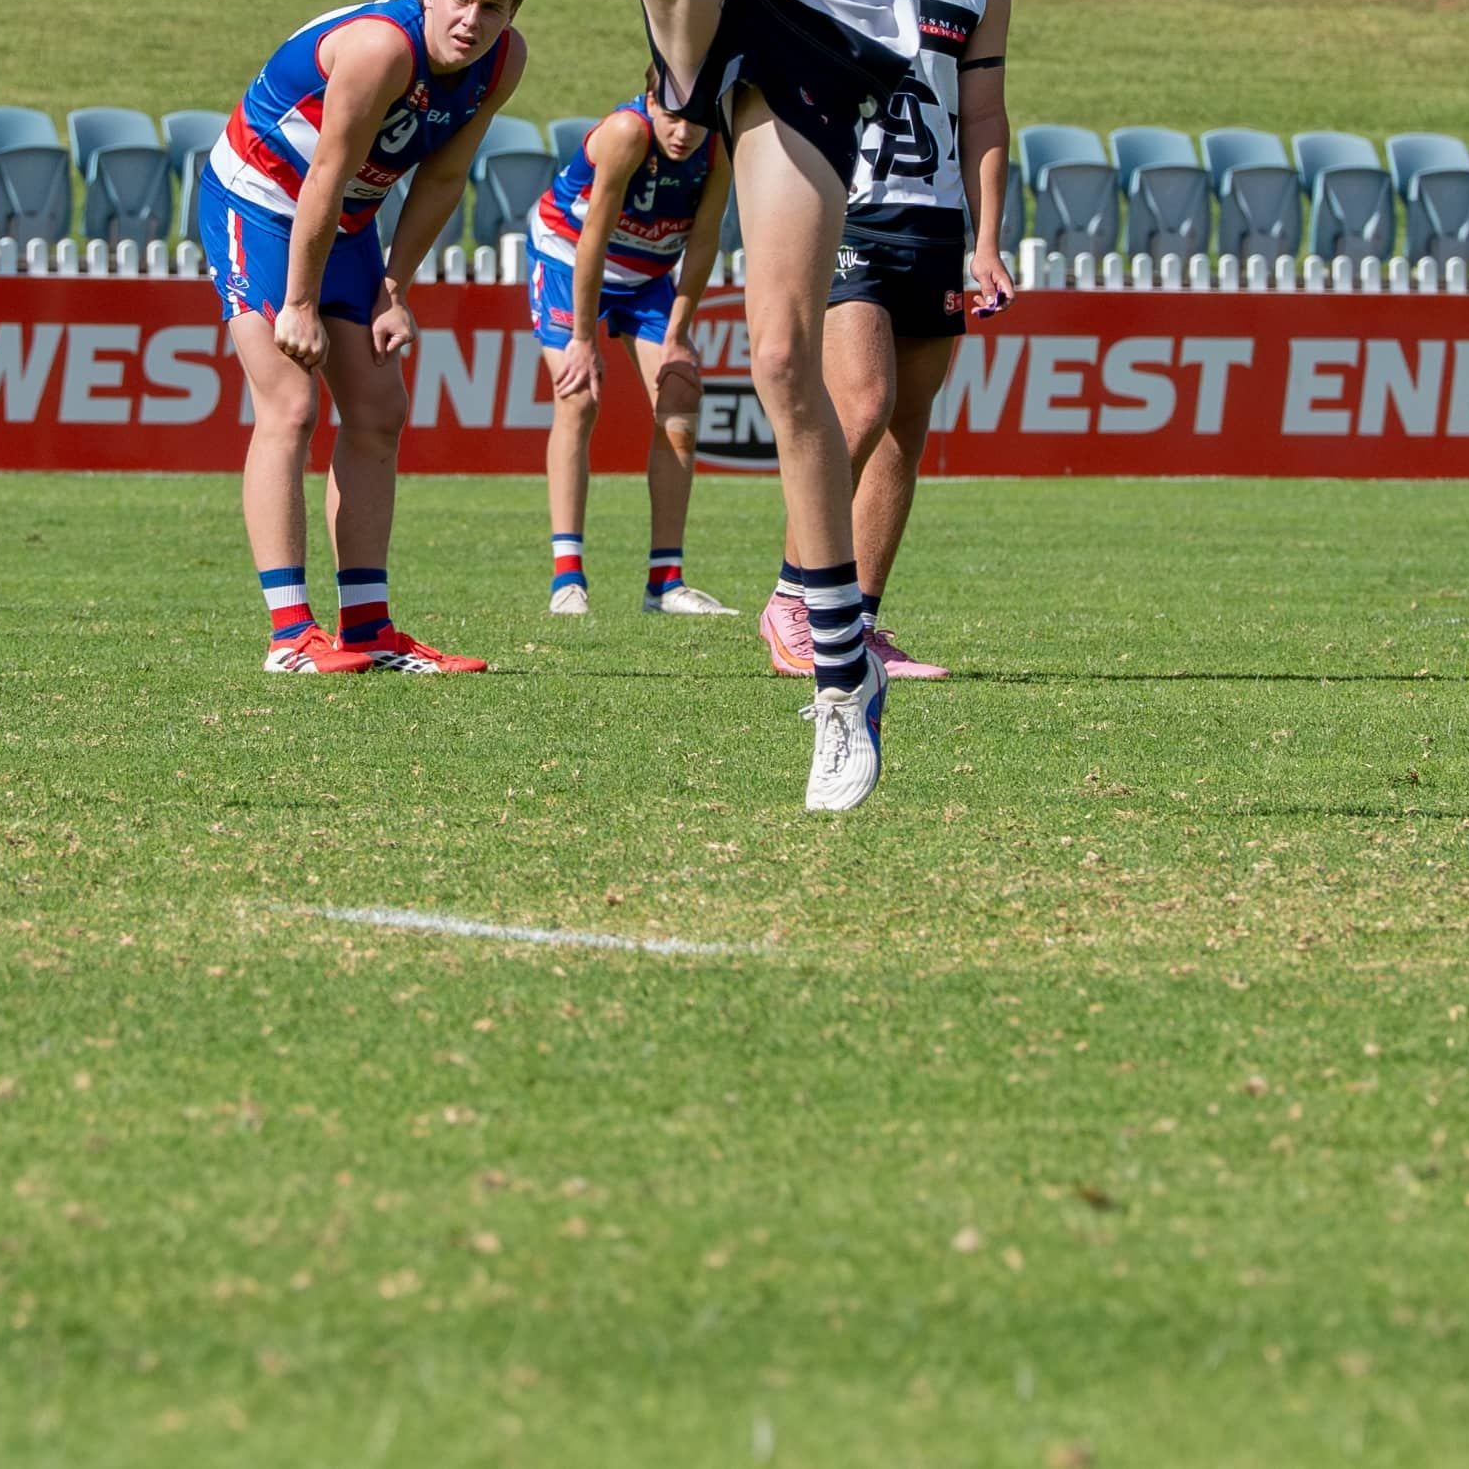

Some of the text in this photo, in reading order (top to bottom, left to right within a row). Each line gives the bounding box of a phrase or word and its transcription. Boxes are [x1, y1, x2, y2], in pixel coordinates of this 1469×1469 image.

[633, 180, 657, 212] 3
[930, 334, 1254, 435] WEST
[697, 394, 776, 443] EN
